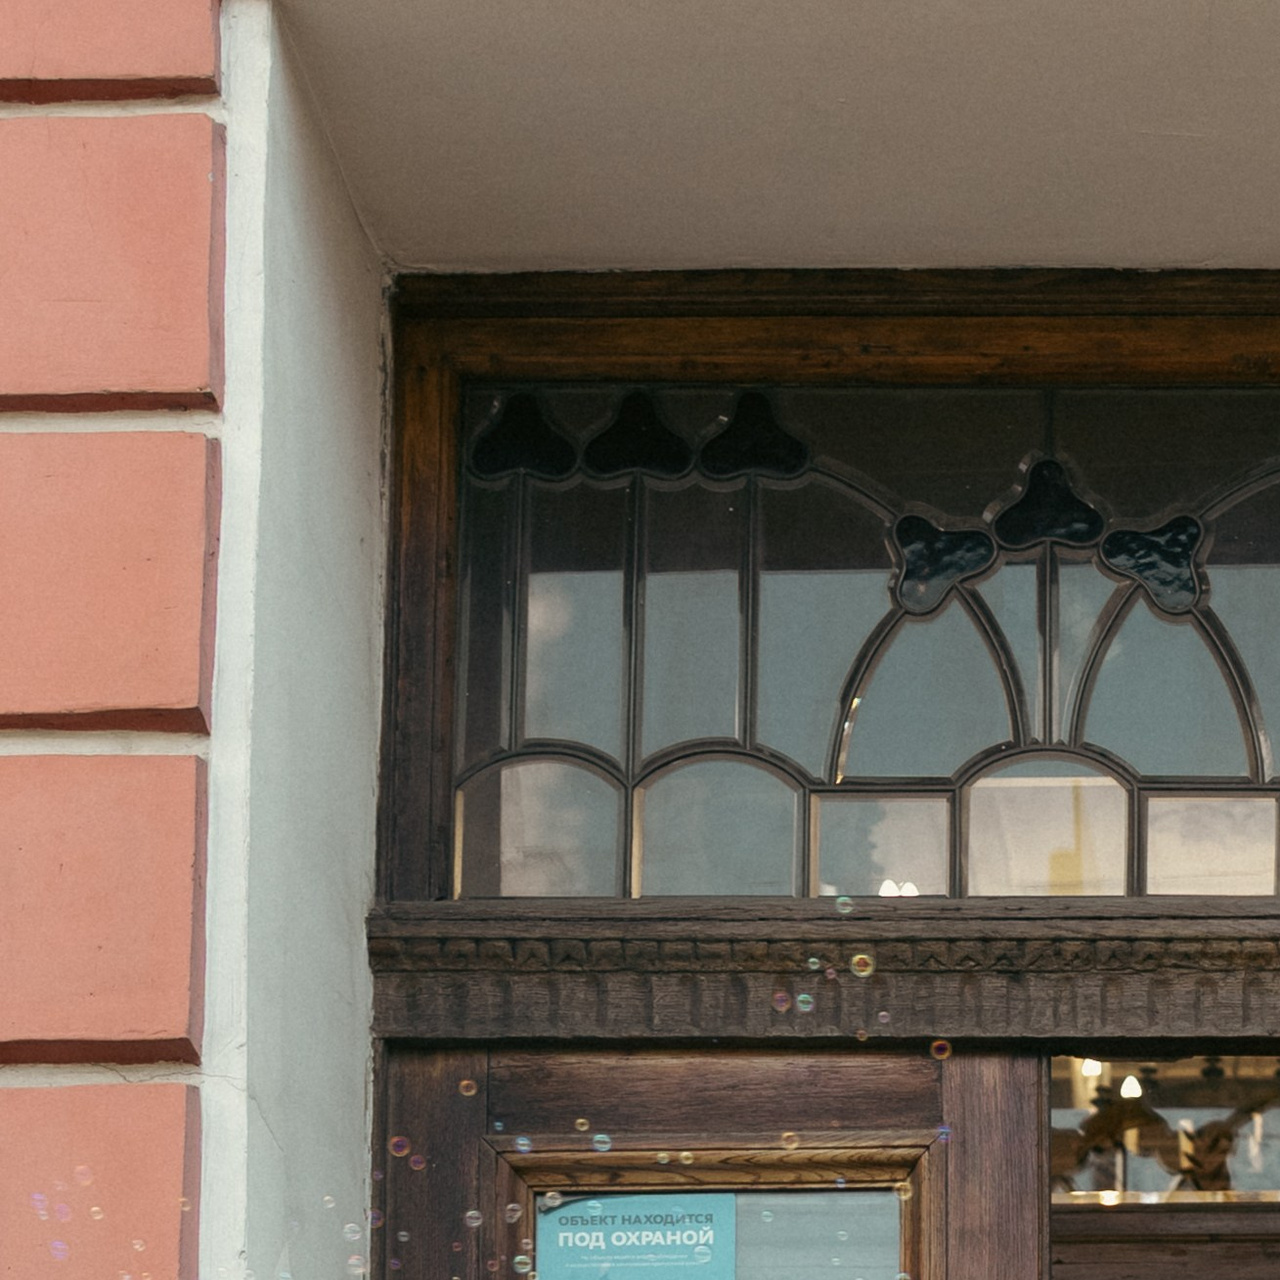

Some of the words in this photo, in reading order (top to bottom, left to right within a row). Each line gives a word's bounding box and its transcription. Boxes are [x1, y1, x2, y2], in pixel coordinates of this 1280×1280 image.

[558, 1215, 617, 1226] ОБЪЕКТ
[621, 1213, 714, 1226] НАХОДИТСЯ
[558, 1231, 606, 1249] ПОД
[611, 1226, 714, 1246] ОХРАНОЙ
